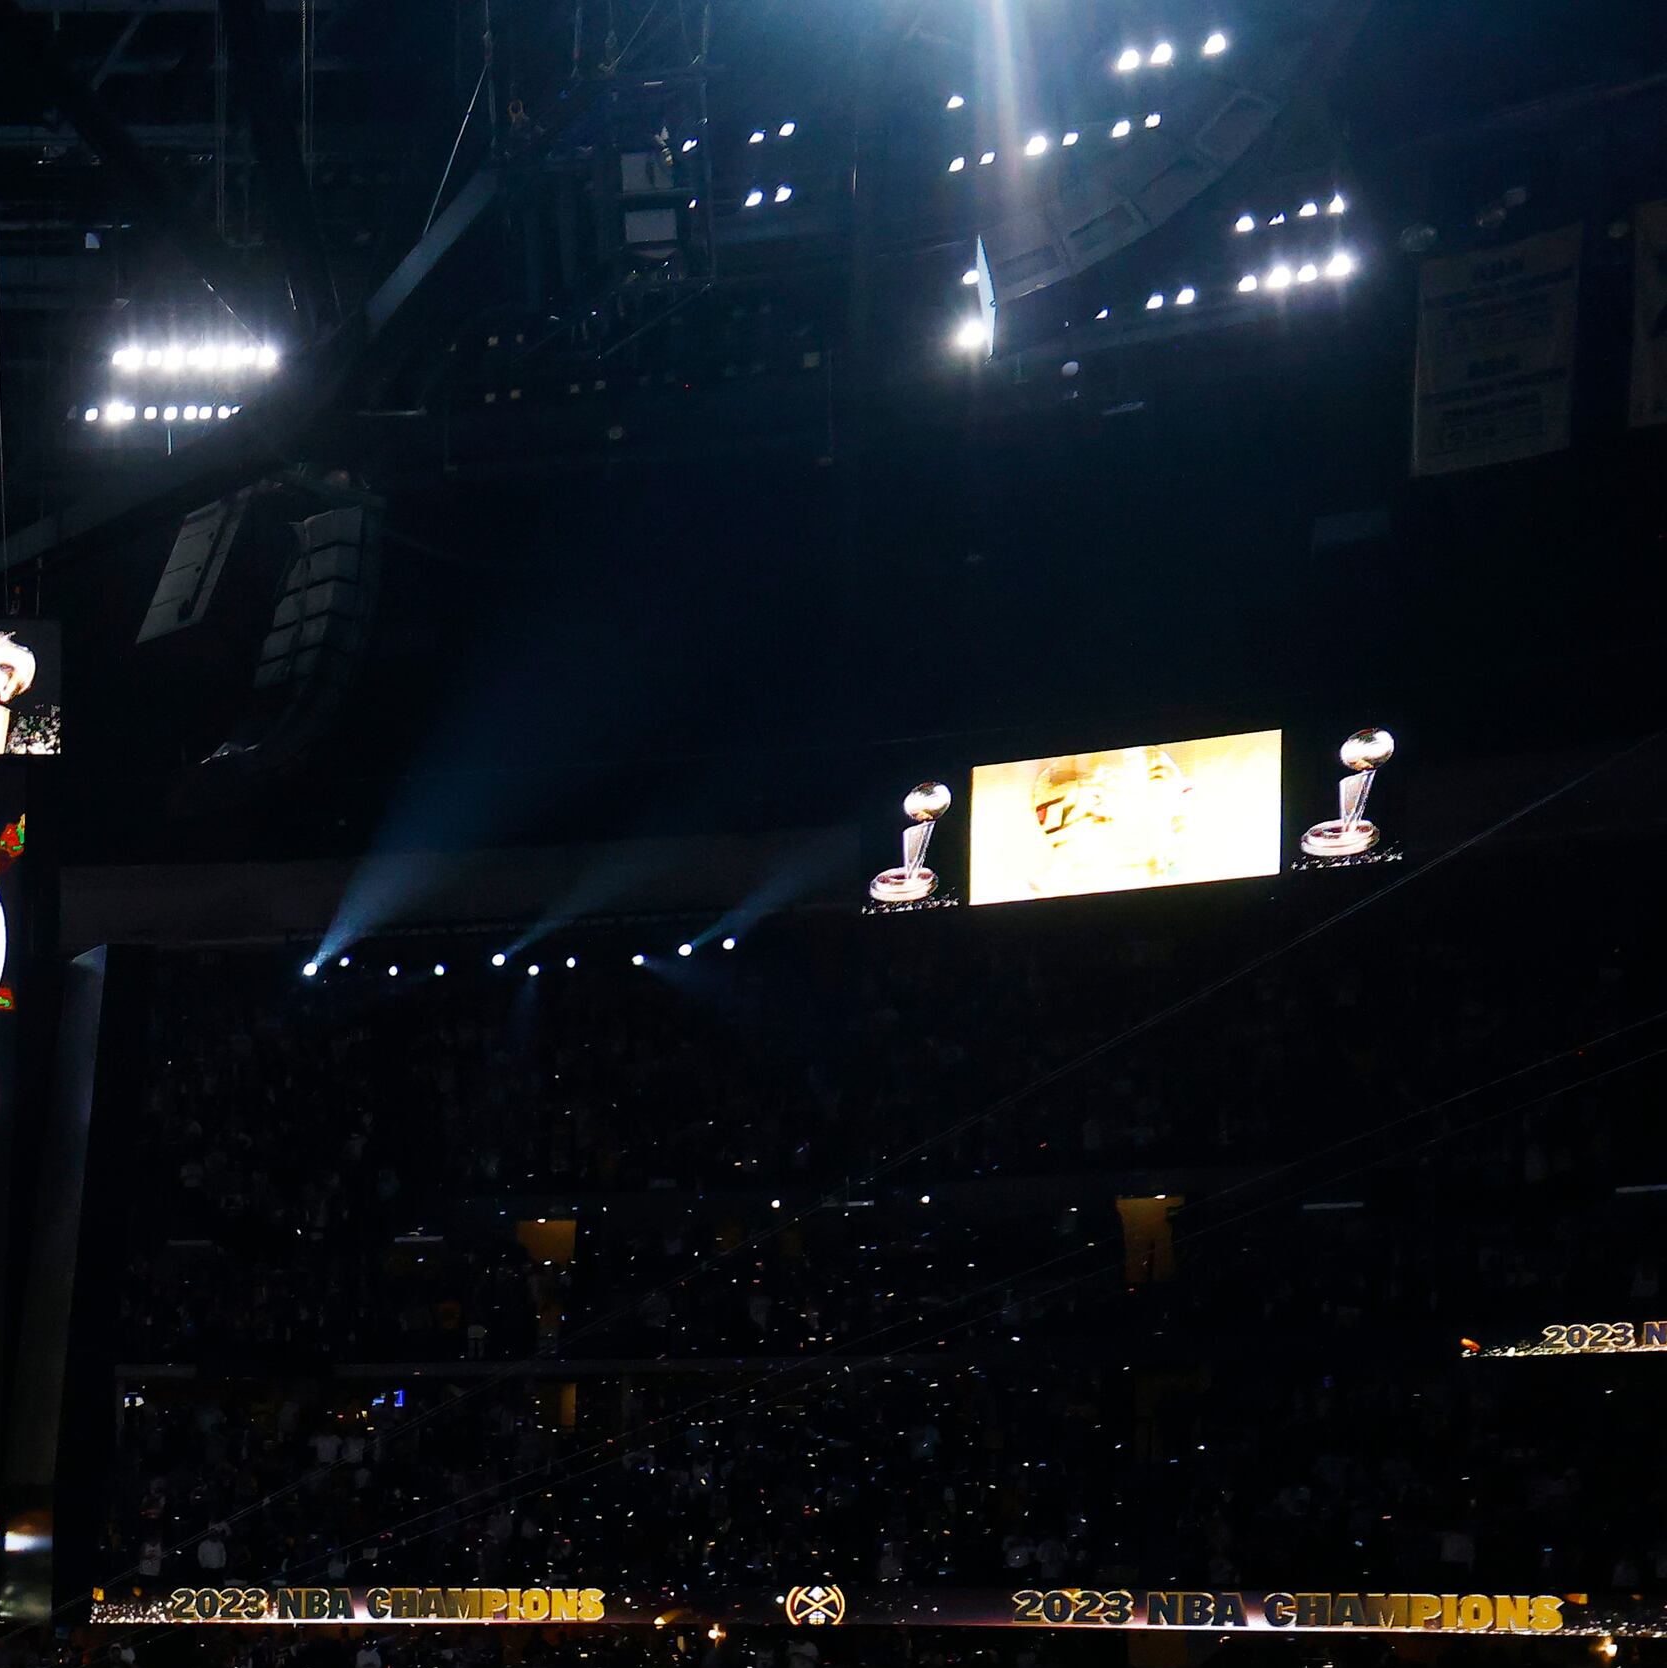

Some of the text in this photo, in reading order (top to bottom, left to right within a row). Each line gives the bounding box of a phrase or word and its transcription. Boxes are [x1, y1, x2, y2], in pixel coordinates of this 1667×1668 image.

[1541, 1322, 1635, 1348] 2023
[169, 1587, 606, 1622] 2023 NBA CHAMPIONS
[1011, 1589, 1565, 1632] 2023 NBA CHAMPIONS
